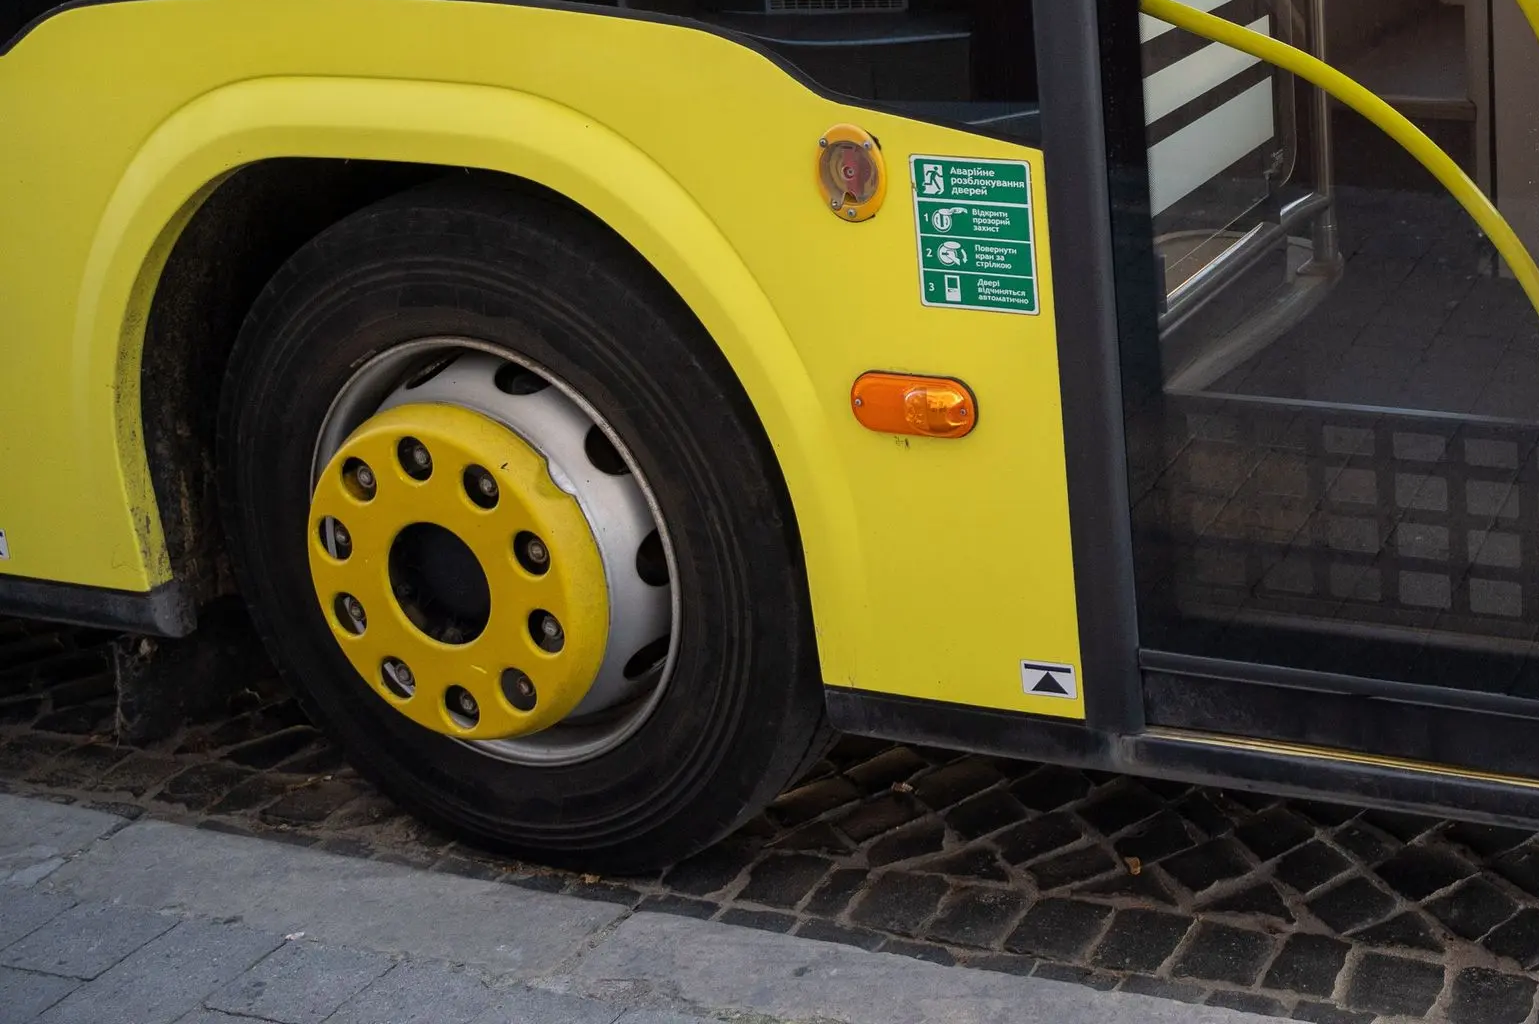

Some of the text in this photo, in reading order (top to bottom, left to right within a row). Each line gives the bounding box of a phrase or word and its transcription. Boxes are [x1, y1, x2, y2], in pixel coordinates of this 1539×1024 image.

[950, 166, 995, 177] Аварійне
[951, 177, 1025, 188] розблокування
[952, 187, 988, 196] дверей
[924, 213, 929, 222] 1
[972, 208, 1008, 219] Відкрити
[973, 217, 1011, 226] прозорий
[973, 225, 1000, 233] захист
[926, 248, 933, 258] 2
[975, 244, 1017, 255] Повернути
[975, 254, 994, 263] кран
[976, 261, 1012, 270] стрілкою
[928, 282, 935, 292] 3
[977, 278, 1000, 288] Двері
[978, 286, 1026, 297] відчиняться
[978, 295, 1029, 304] автоматично
